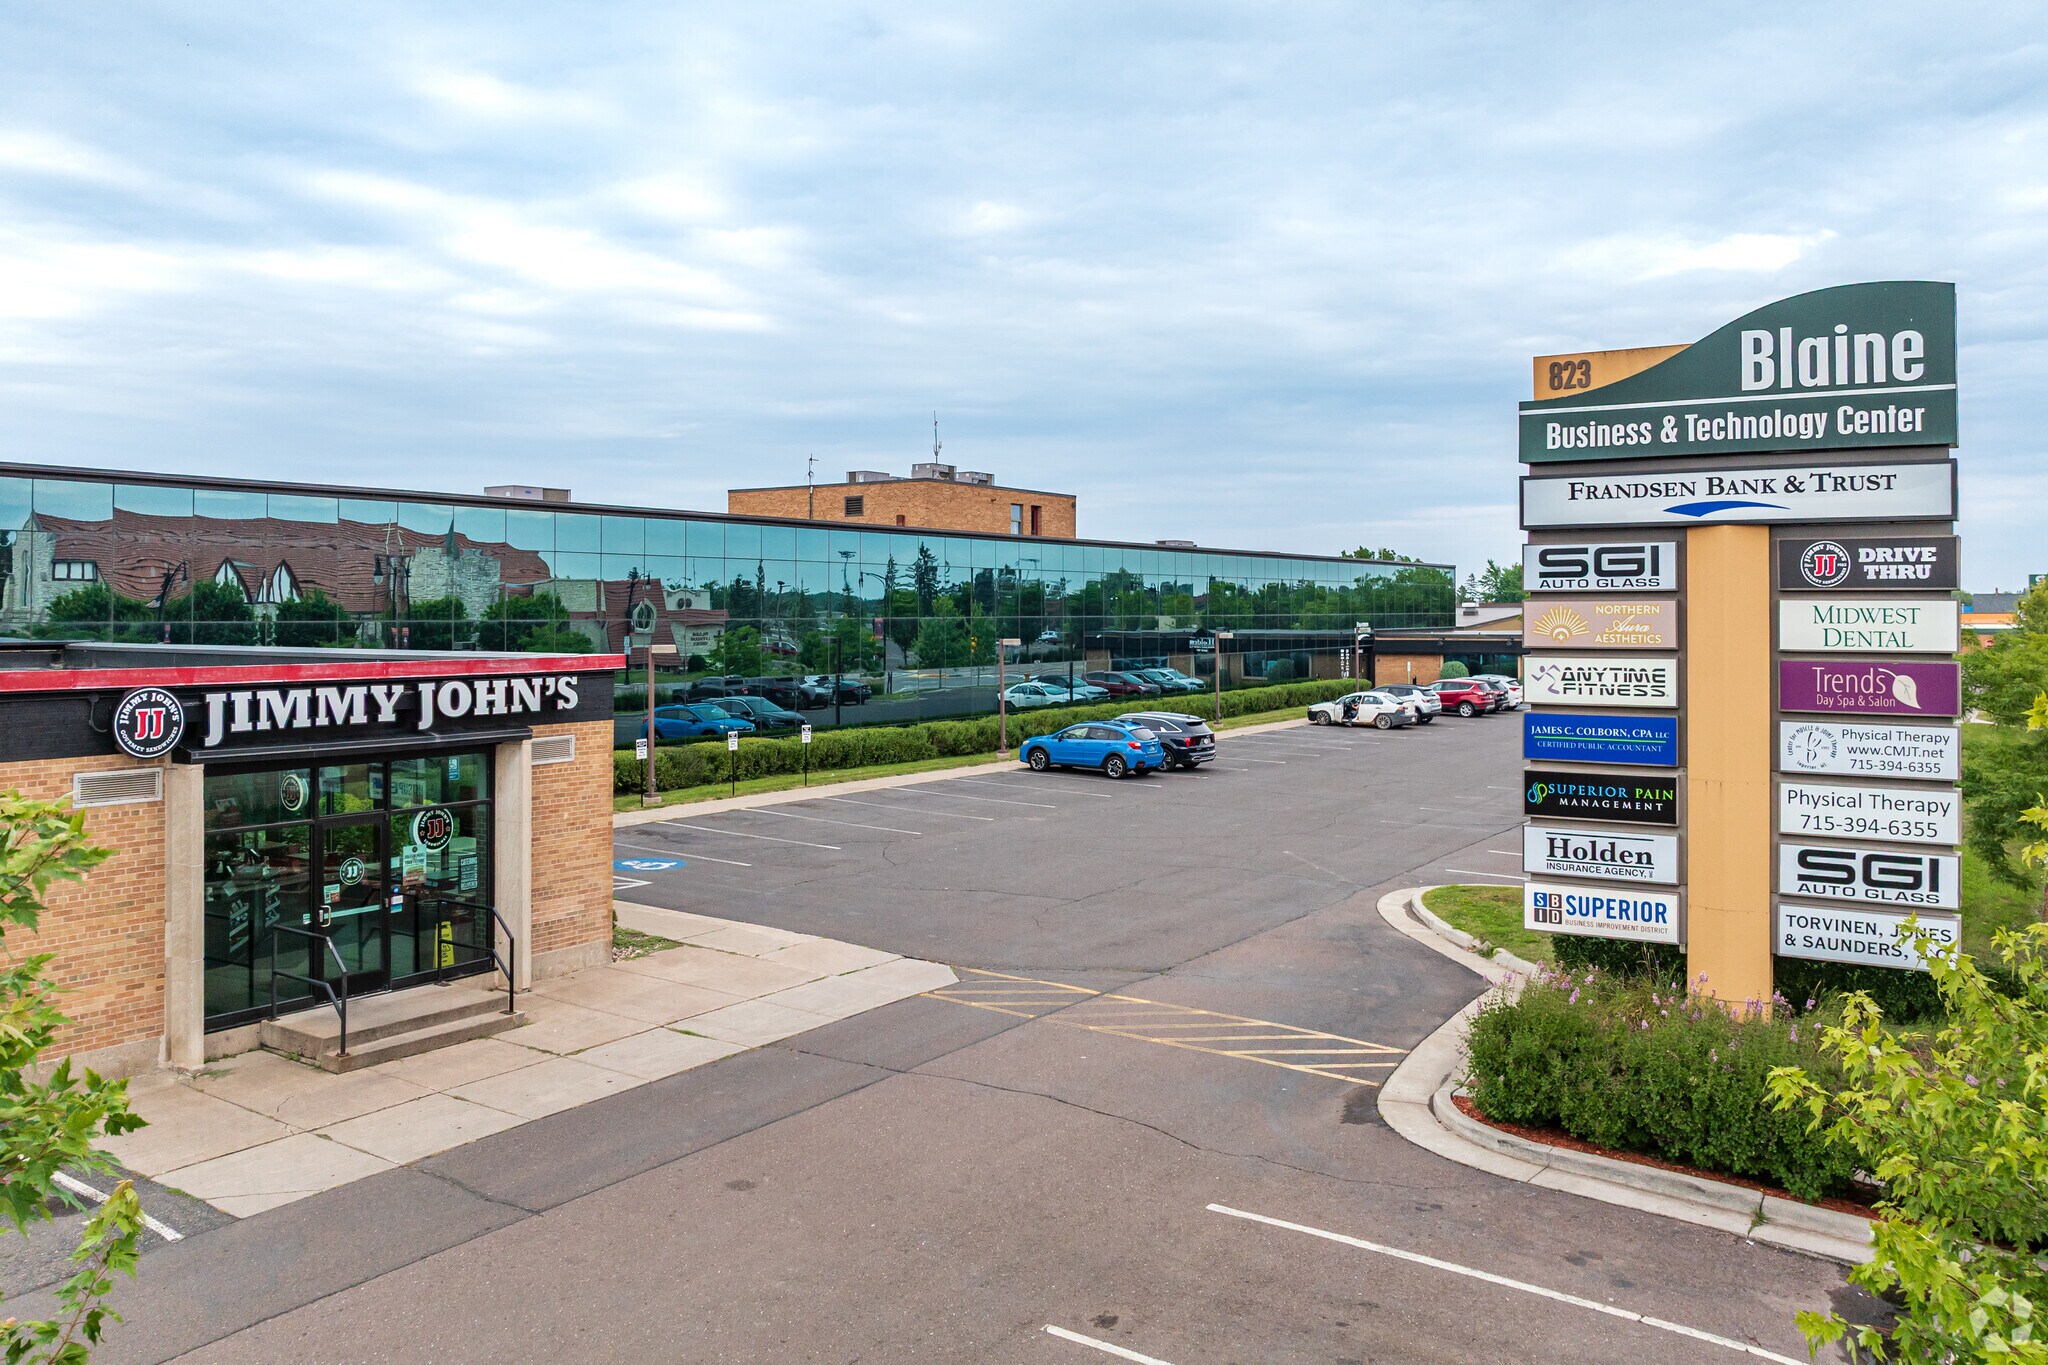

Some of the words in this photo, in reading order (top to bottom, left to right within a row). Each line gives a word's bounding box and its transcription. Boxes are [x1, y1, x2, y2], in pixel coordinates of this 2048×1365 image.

[1741, 324, 1925, 391] Blaine
[1549, 359, 1592, 391] 823
[1546, 419, 1652, 450] Business
[1660, 415, 1678, 443] &
[1685, 409, 1828, 441] Technology
[1837, 405, 1925, 435] Center
[1783, 474, 1806, 495] &
[1538, 545, 1660, 579] SGI
[1813, 554, 1838, 577] JJ
[1858, 547, 1937, 563] DRIVE
[1863, 564, 1932, 580] THRU
[1539, 579, 1590, 589] AUTO
[1596, 578, 1661, 588] GLASS
[1594, 605, 1661, 615] NORTHERN
[1812, 604, 1921, 625] MIDWEST
[1605, 614, 1651, 633] Aura
[1594, 634, 1662, 644] AESTHETICS
[1822, 627, 1914, 648] DENTAL
[1560, 666, 1666, 684] ANYTIME
[1812, 667, 1886, 694] Trends
[1562, 683, 1667, 697] FITNESS
[119, 693, 148, 725] JIMMY
[150, 692, 180, 722] JOHN'S
[204, 685, 404, 747] JIMMY
[416, 676, 579, 731] JOHN'S
[1816, 694, 1834, 708] Day
[1837, 694, 1855, 708] Spa
[1857, 696, 1866, 707] &
[1868, 695, 1896, 707] Salon
[134, 707, 166, 740] JJ
[1531, 725, 1563, 735] JAMES
[1565, 726, 1574, 735] C.
[1576, 727, 1631, 738] COLBORN,
[1632, 729, 1653, 738] CPA
[120, 729, 145, 752] GOURMET
[145, 726, 179, 753] SANDWICHES
[1537, 741, 1577, 749] CERTIFIED
[1577, 742, 1606, 750] PUBLIC
[1607, 743, 1663, 753] ACCOUNTANT
[1841, 728, 1892, 743] Physical
[1896, 731, 1951, 746] Therapy
[1846, 745, 1944, 759] www.CMJT.net
[1850, 759, 1941, 774] 715-394-6355
[1548, 783, 1629, 798] SUPERIOR
[1635, 788, 1674, 801] PAIN
[1559, 798, 1664, 812] MANAGEMENT
[1787, 789, 1862, 809] Physical
[1868, 794, 1951, 817] Therapy
[427, 818, 444, 839] JJ
[1800, 814, 1938, 838] 715-394-6355
[1546, 836, 1654, 866] Holden
[1546, 862, 1602, 874] INSURANCE
[1604, 867, 1647, 879] AGENCY,
[1797, 849, 1940, 893] SGI
[1797, 883, 1856, 897] AUTO
[1864, 889, 1940, 904] GLASS
[1565, 894, 1668, 924] SUPERIOR
[1565, 919, 1595, 929] BUSINESS
[1595, 921, 1639, 932] IMPROVEMENT
[1640, 925, 1669, 935] DISTRICT
[1785, 914, 1884, 939] TORVINEN,
[1784, 934, 1797, 947] &
[1802, 935, 1909, 961] SAUNDERS,
